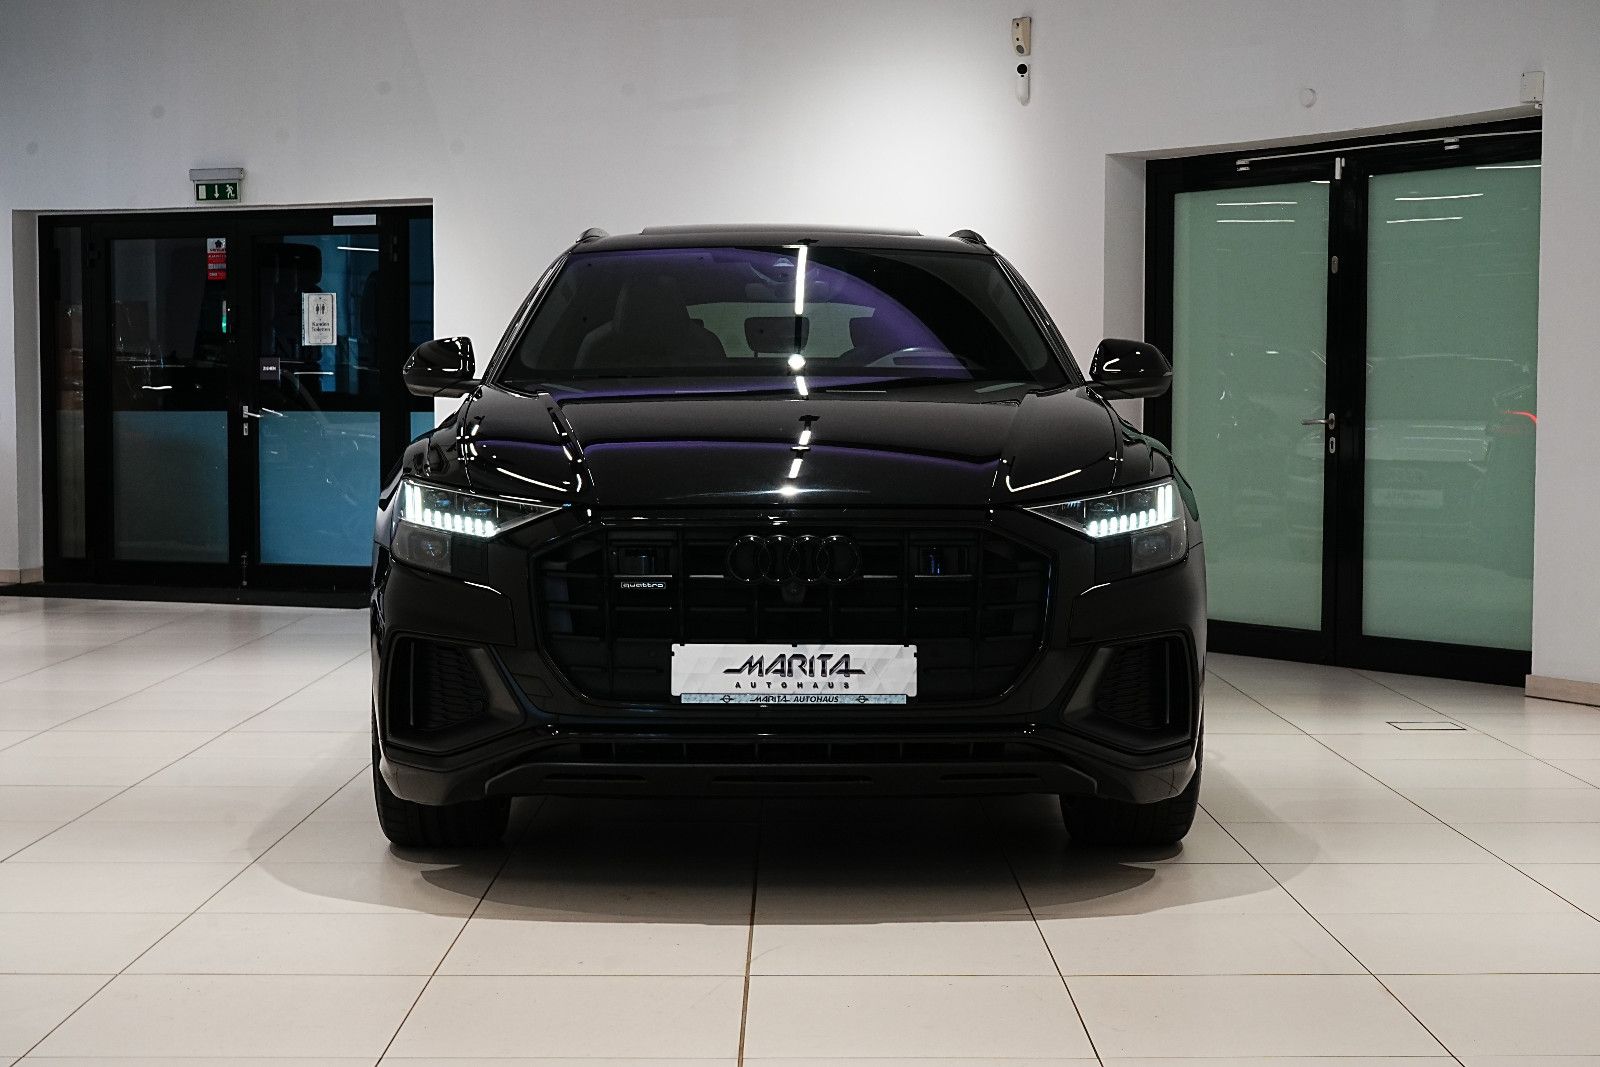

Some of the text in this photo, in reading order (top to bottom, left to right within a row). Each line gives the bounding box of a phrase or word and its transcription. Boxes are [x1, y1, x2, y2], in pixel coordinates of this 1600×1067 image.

[722, 653, 866, 678] MARITA
[735, 681, 850, 689] AUTOHAUS
[750, 695, 839, 703] MARITA AUTOHAUS
